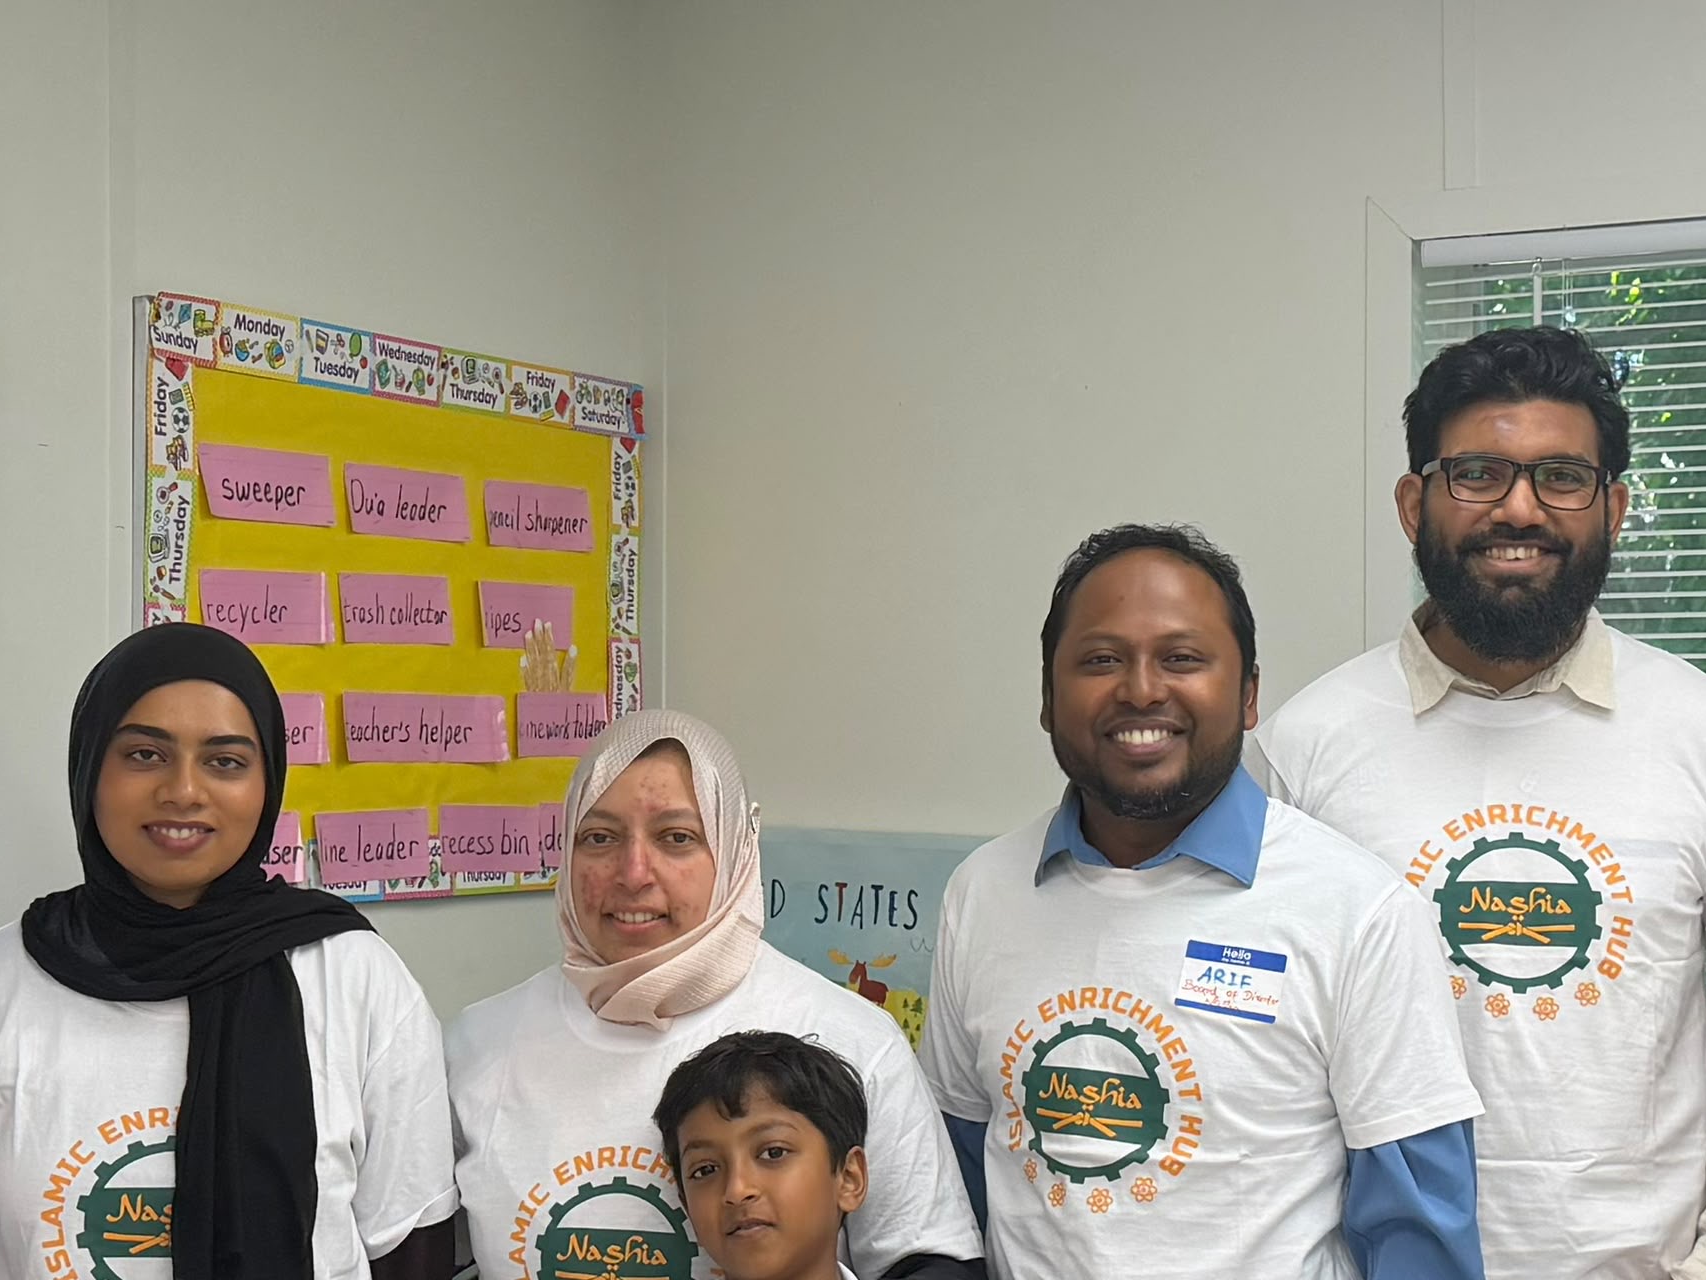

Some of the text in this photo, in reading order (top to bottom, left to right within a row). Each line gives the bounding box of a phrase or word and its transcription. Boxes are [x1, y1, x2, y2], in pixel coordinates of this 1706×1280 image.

[152, 313, 622, 429] Sunday Monday Tuesday Wednesday Thursday Friday Saturday
[154, 376, 170, 437] Friday
[221, 478, 306, 511] sweeper
[612, 451, 623, 500] Friday
[395, 484, 447, 523] leader
[489, 495, 588, 536] pencil sharpener
[169, 494, 191, 585] Thursday
[625, 548, 638, 622] Thursday
[206, 584, 288, 633] recycler
[343, 592, 447, 626] trash collector
[484, 605, 522, 638] ipes
[419, 707, 473, 752] helper
[357, 822, 419, 862] leader
[441, 835, 494, 855] recess
[501, 818, 530, 856] bin
[814, 881, 918, 930] STATES
[1442, 803, 1634, 980] ENRICHMENT HUB
[1459, 886, 1573, 915] Nashia
[1197, 966, 1253, 989] ARIF
[1226, 990, 1237, 999] of
[1000, 986, 1204, 1177] ISLAMIC ENRICHMENT HUB
[1038, 1071, 1142, 1110] Nashia
[552, 1145, 677, 1186] ENRICH
[557, 1232, 667, 1266] Nashia
